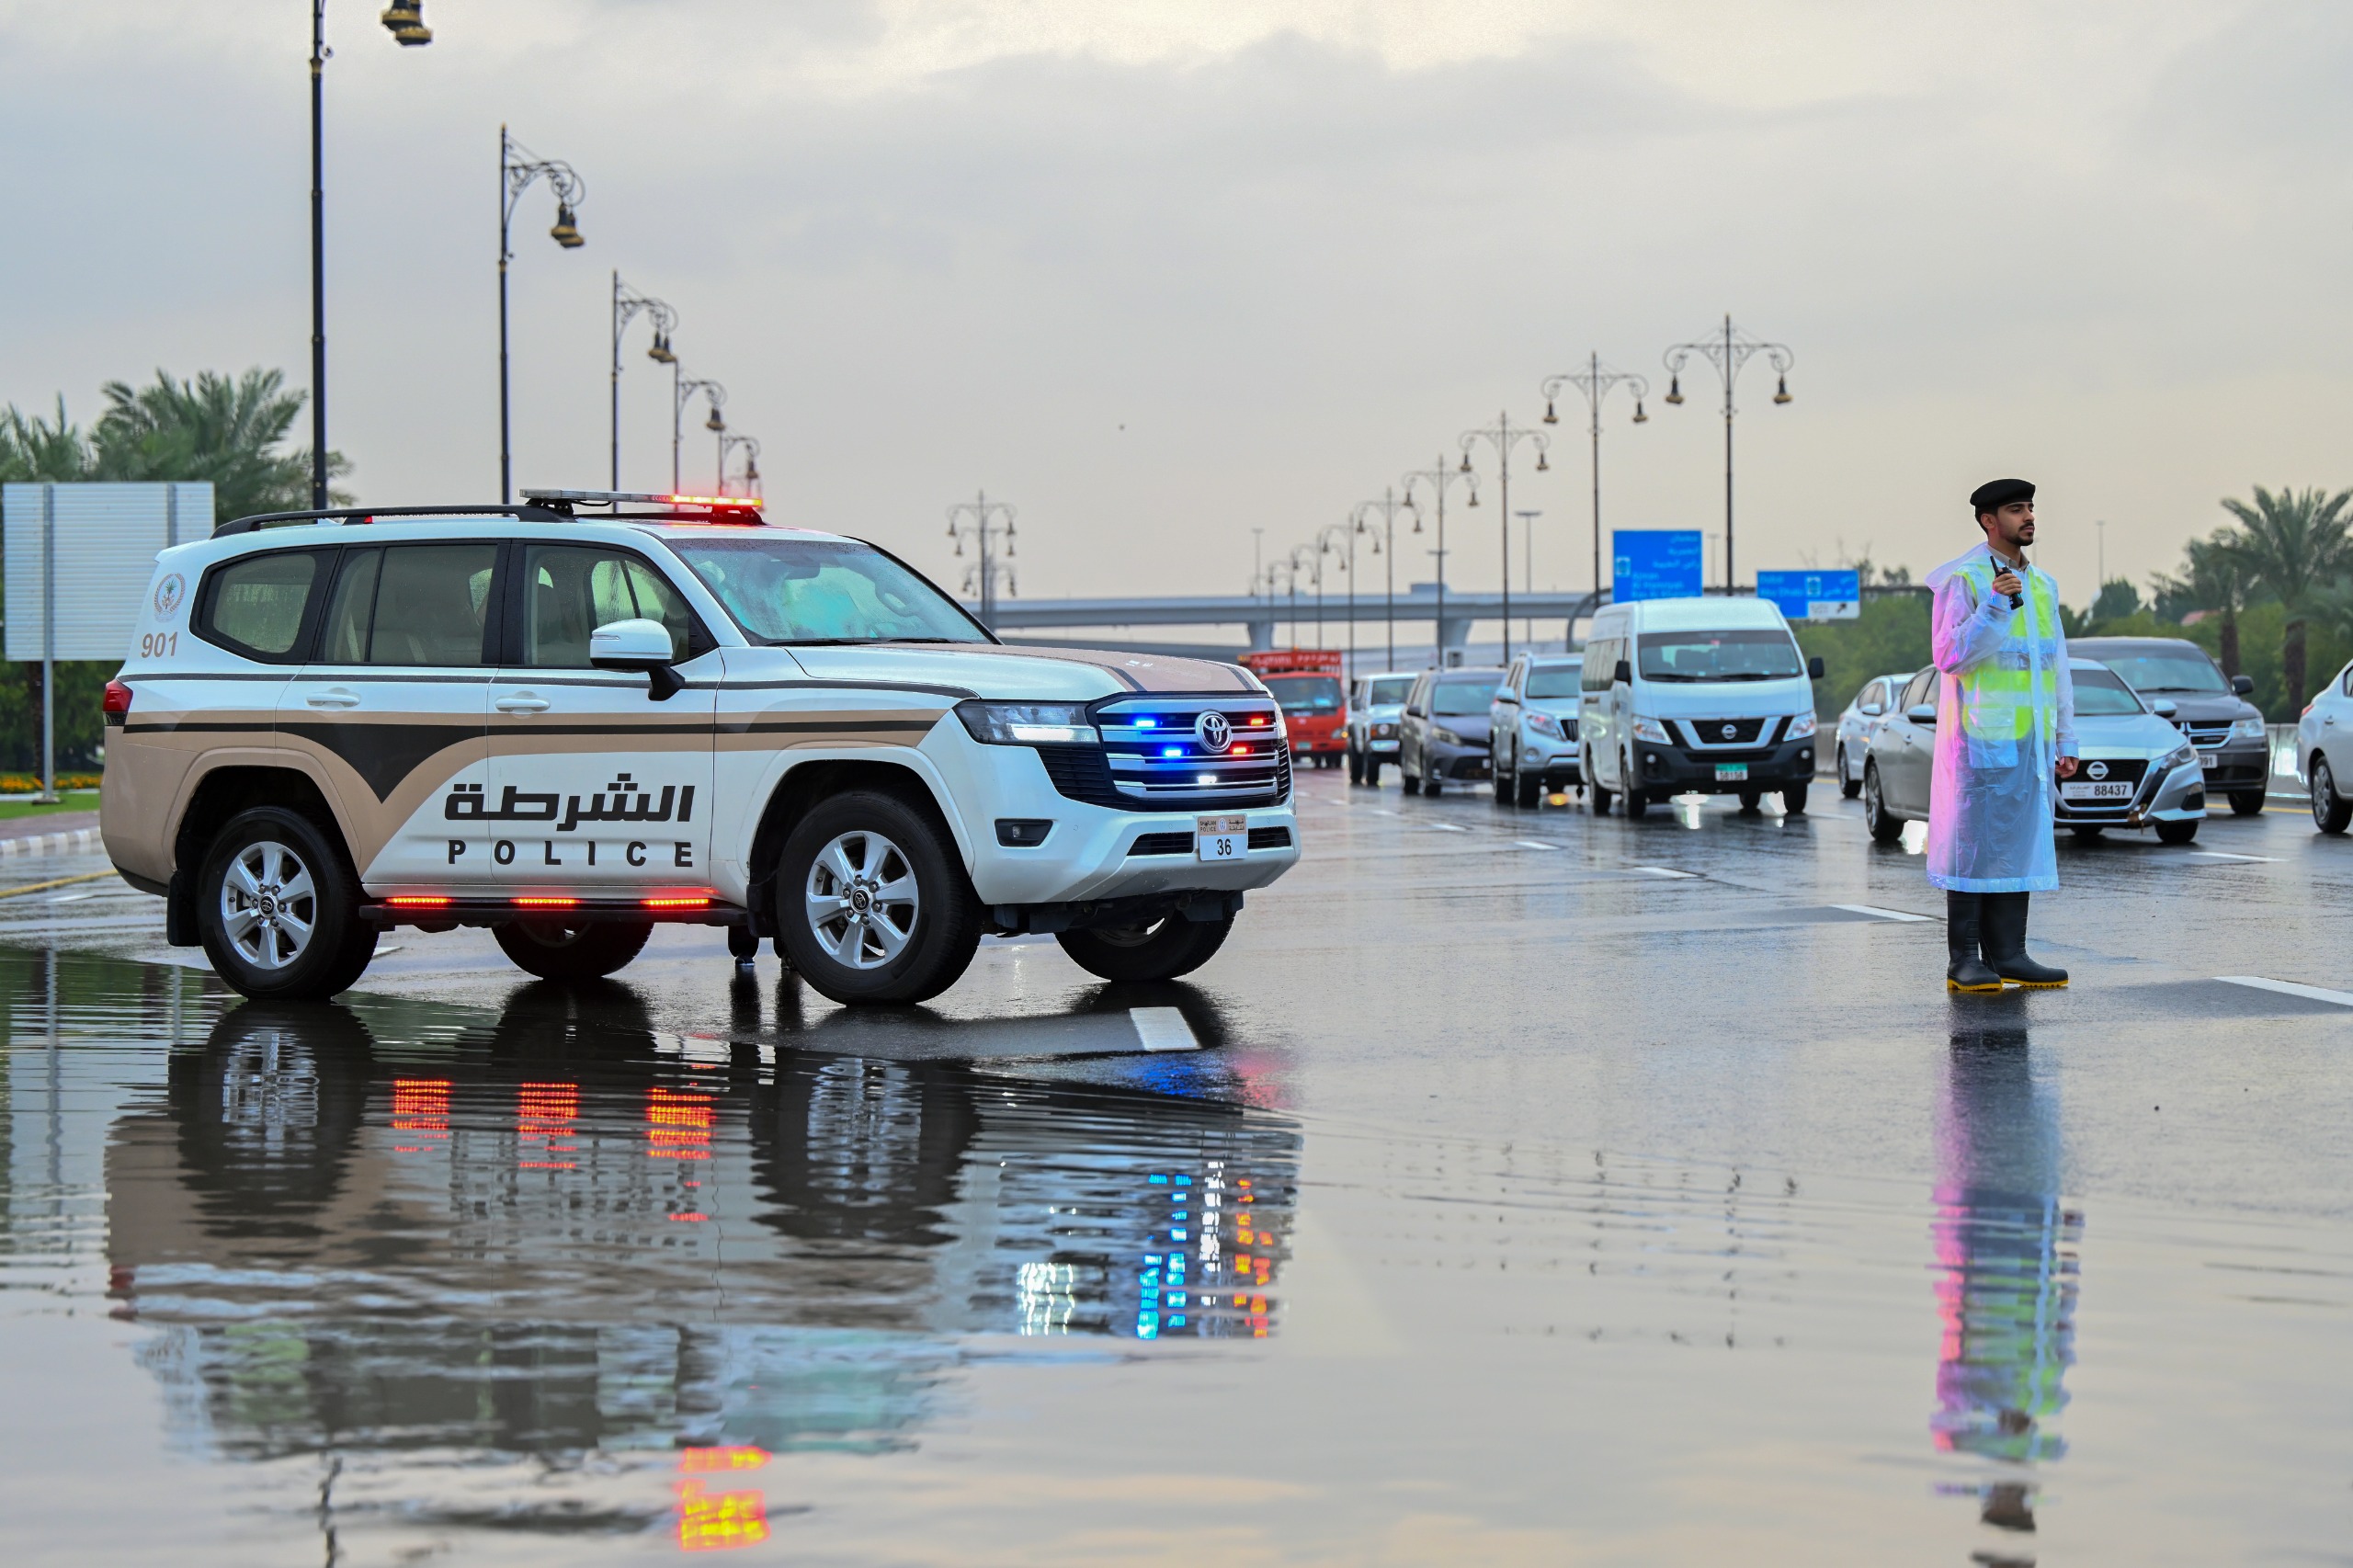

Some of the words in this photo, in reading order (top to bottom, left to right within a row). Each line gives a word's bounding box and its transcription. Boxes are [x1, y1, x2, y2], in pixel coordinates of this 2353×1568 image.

[142, 631, 177, 658] 901
[445, 773, 695, 832] الشرطة
[2094, 784, 2127, 797] 88437
[448, 840, 693, 868] POLICE
[1217, 838, 1232, 856] 36
